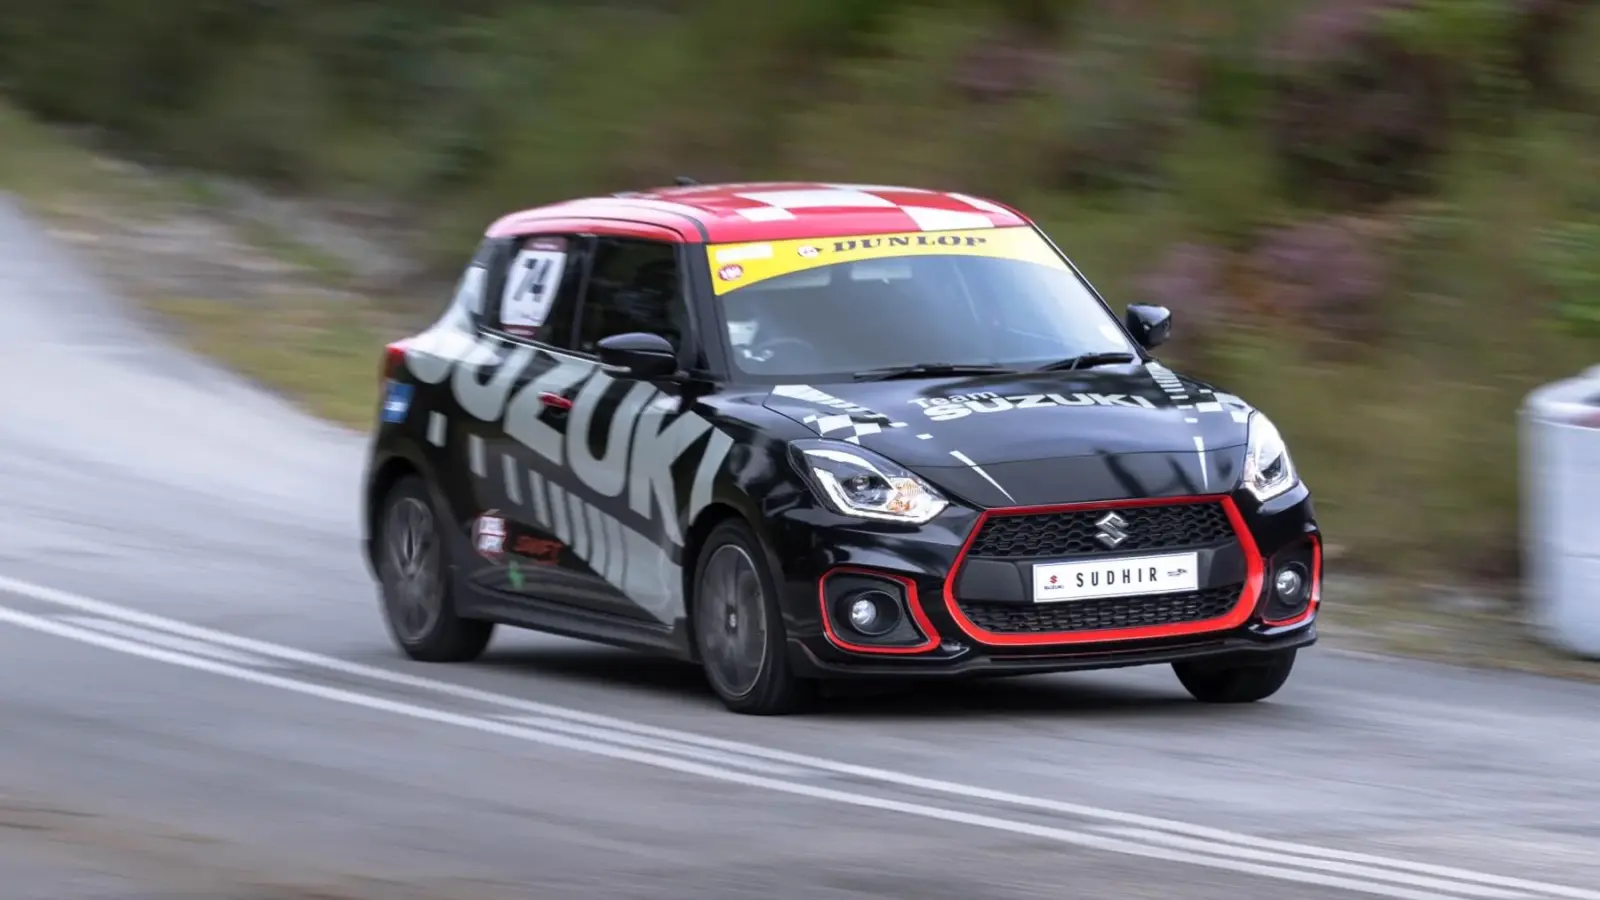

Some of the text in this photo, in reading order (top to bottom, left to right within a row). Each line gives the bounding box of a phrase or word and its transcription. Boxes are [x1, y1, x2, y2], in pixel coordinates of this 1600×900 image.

[832, 235, 988, 253] DUNLOP
[908, 390, 998, 409] Team
[923, 393, 1157, 421] SUZUKI
[404, 275, 733, 546] SUZUKI
[1076, 567, 1157, 588] SUDHIR
